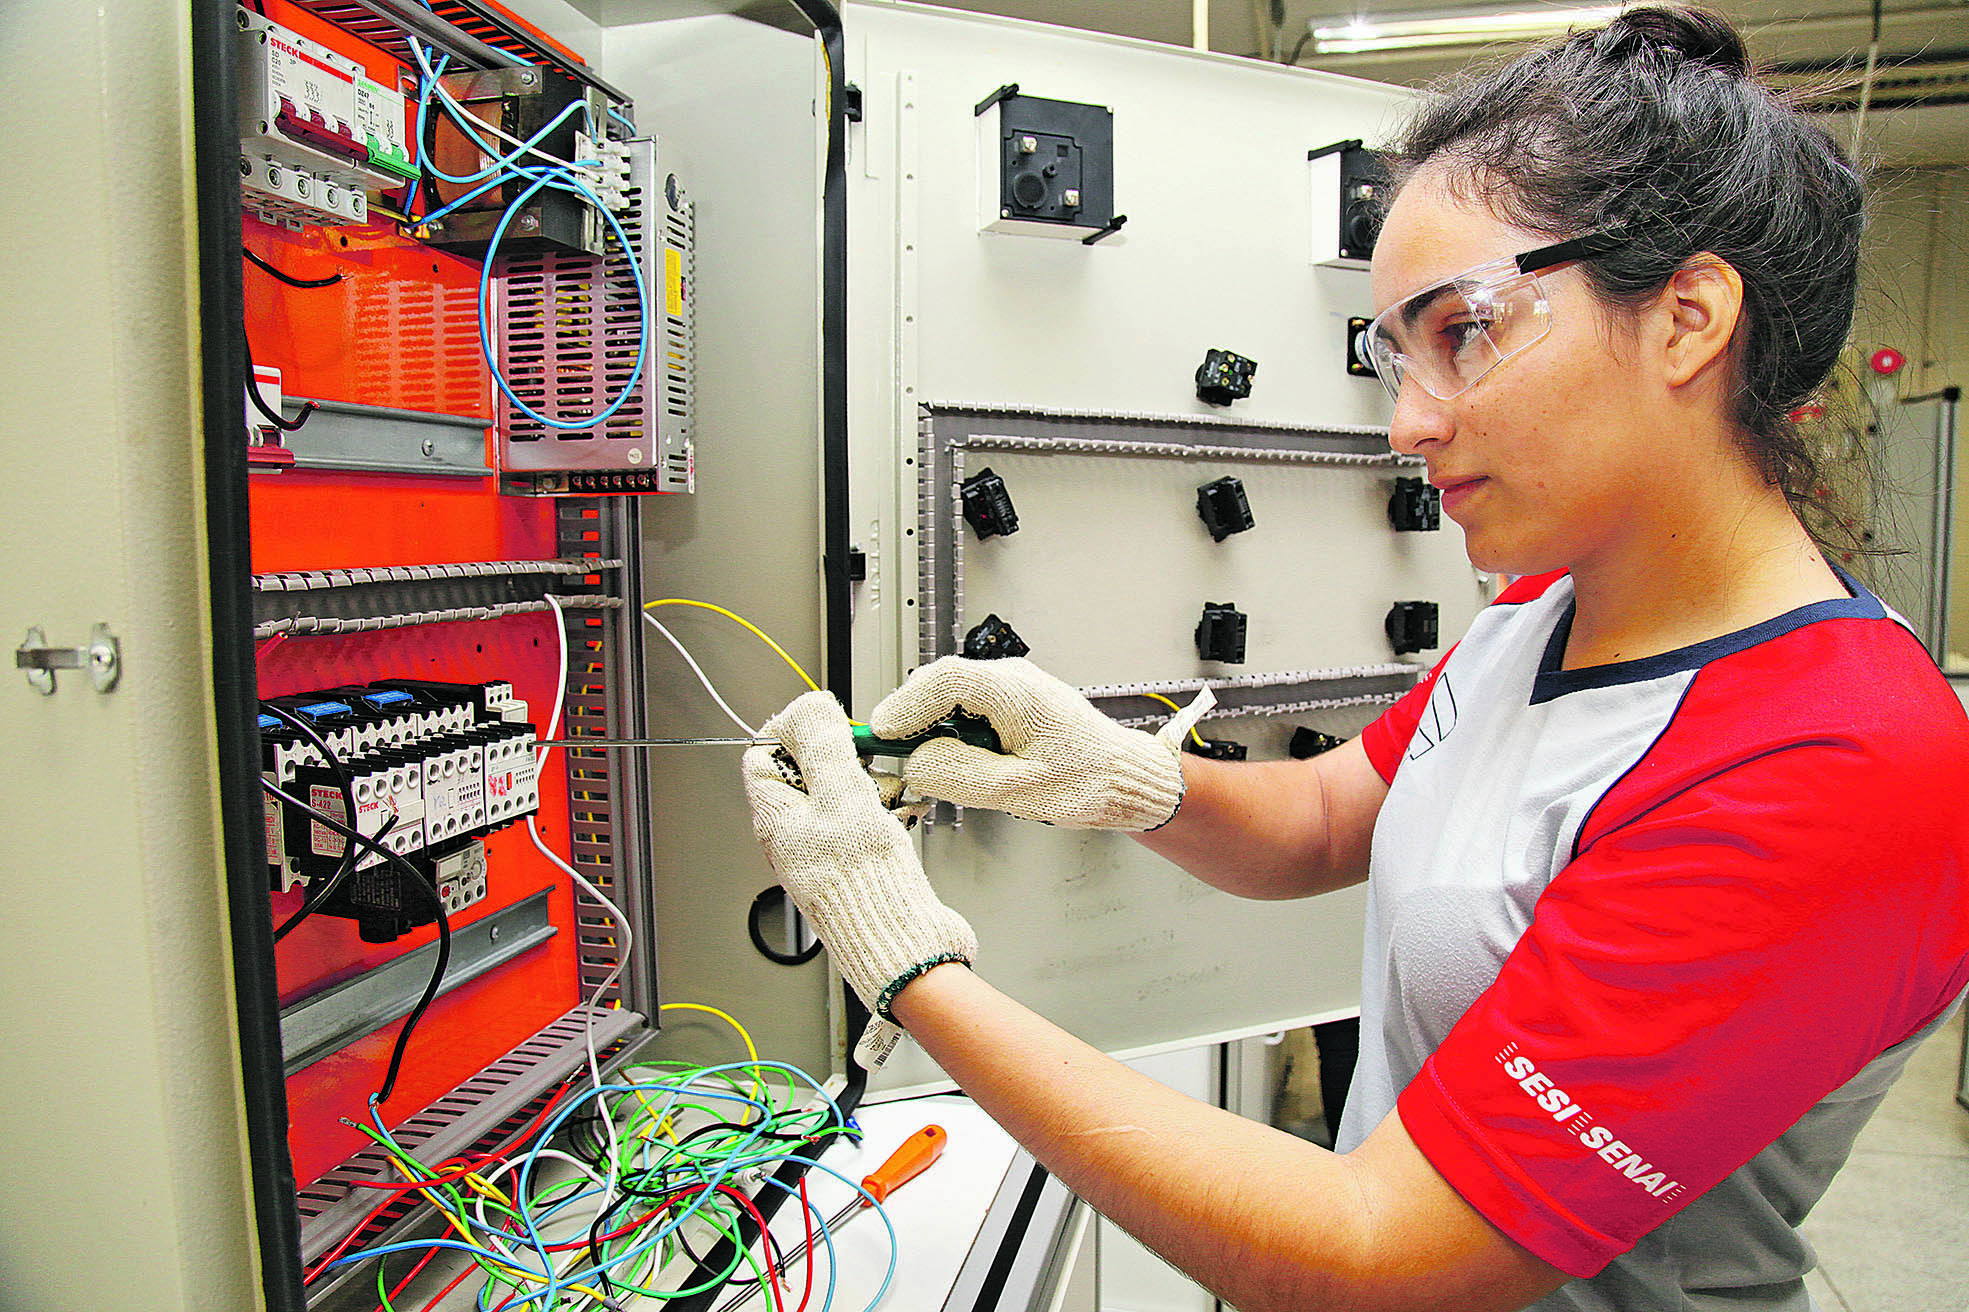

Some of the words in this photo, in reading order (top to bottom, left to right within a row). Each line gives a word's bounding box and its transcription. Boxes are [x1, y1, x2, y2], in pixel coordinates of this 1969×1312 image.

[270, 37, 299, 58] STECK
[311, 788, 343, 800] STECK
[311, 800, 332, 810] S-422
[358, 801, 379, 814] STECK
[1504, 1056, 1582, 1122] SESI
[1579, 1126, 1678, 1198] SENAI
